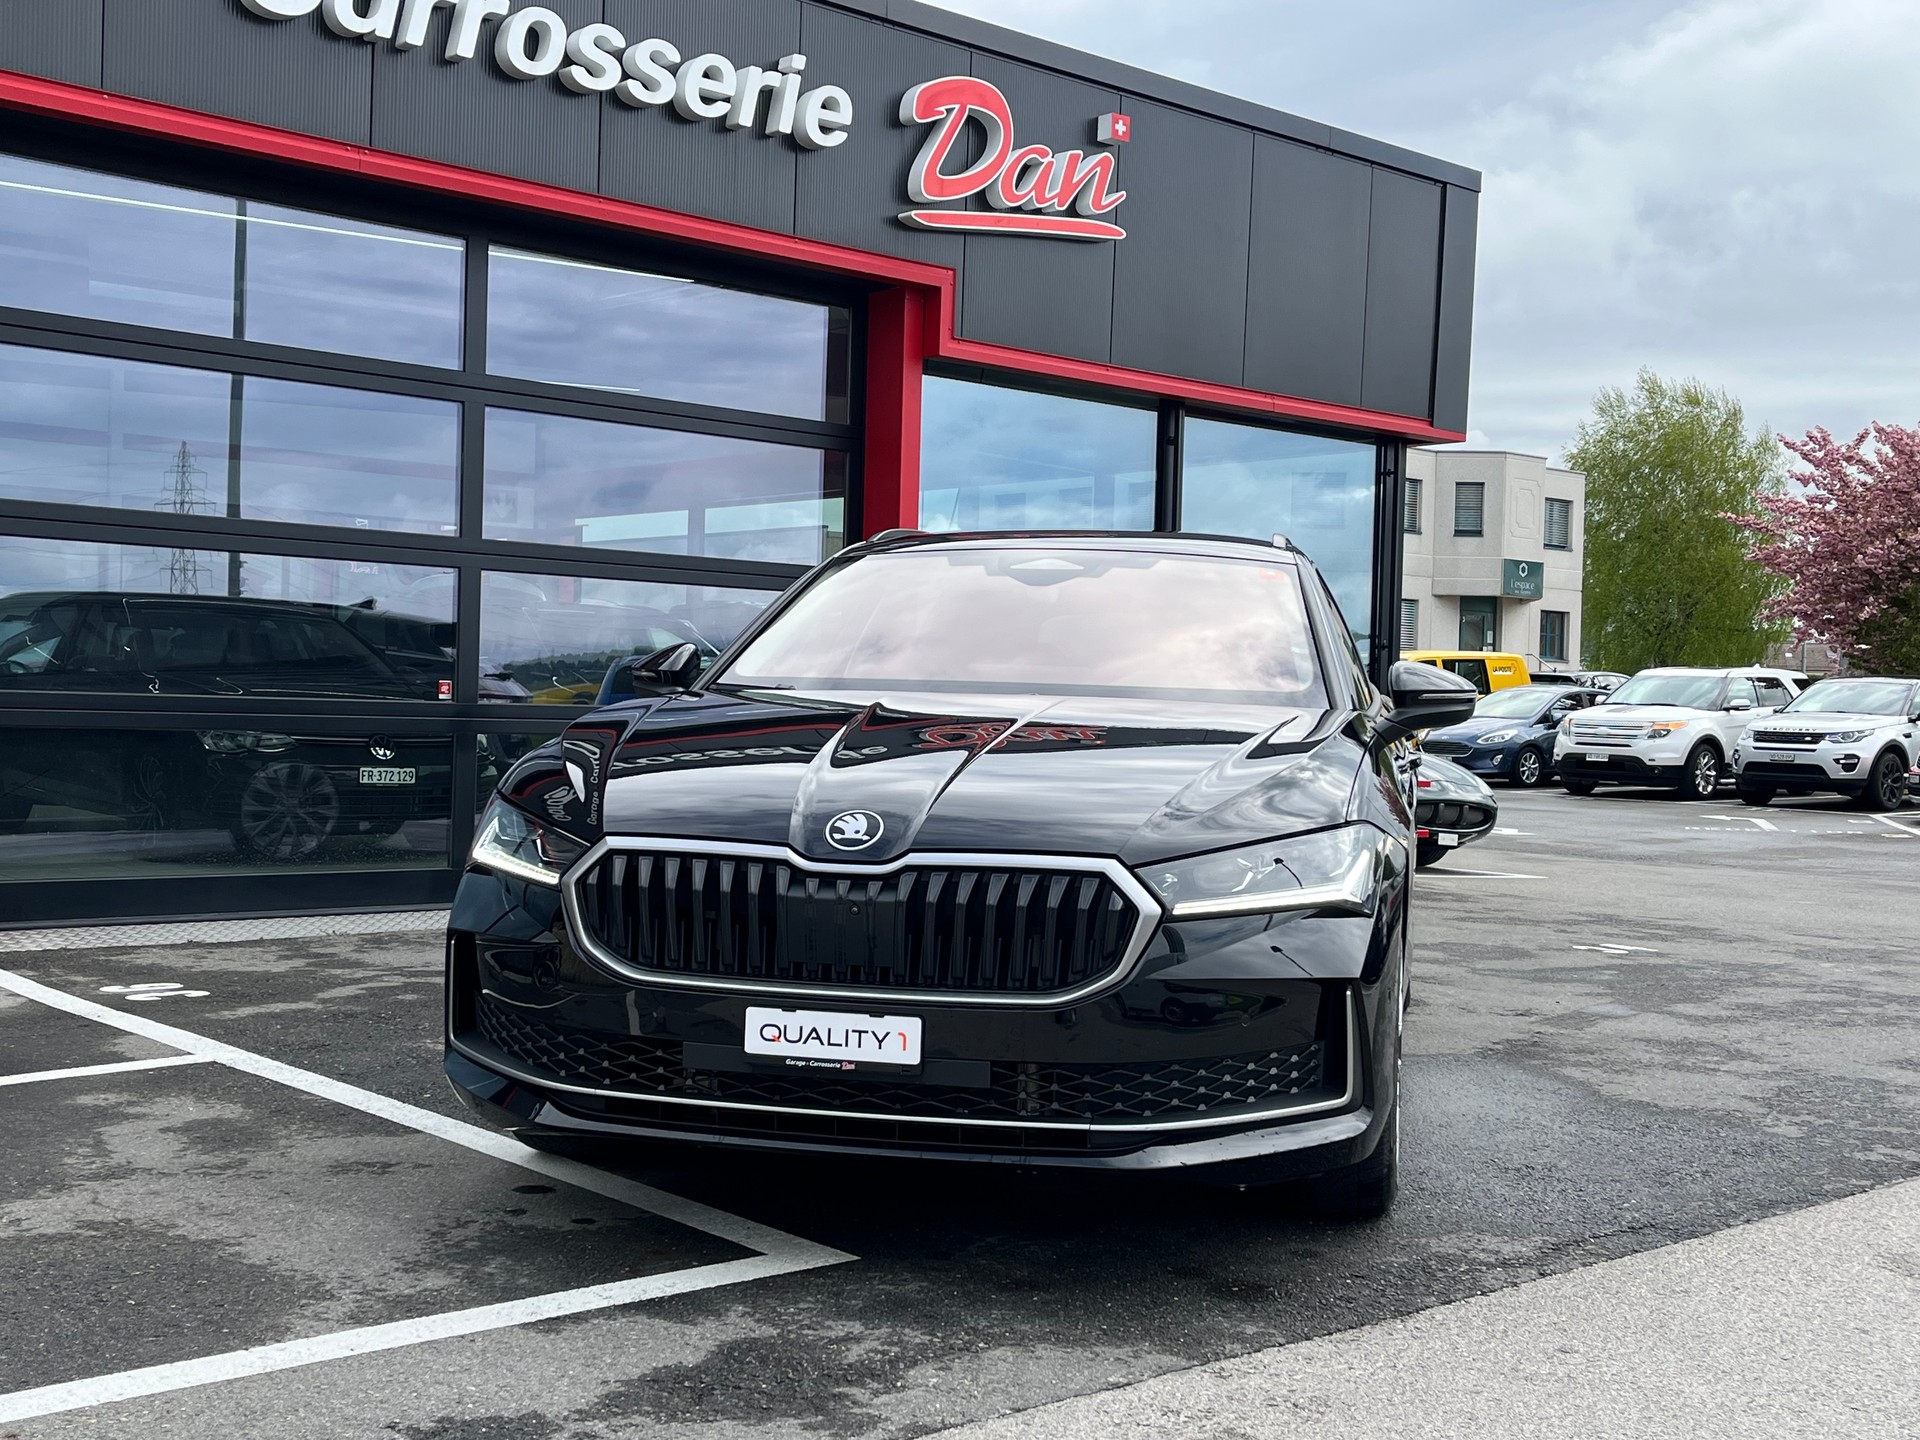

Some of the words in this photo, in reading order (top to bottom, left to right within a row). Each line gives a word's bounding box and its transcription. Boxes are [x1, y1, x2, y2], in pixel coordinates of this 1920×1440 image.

[240, 0, 852, 149] arrosserie
[759, 1023, 891, 1050] QUALITY
[785, 1058, 806, 1067] Garage
[809, 1060, 841, 1069] Carrosserie
